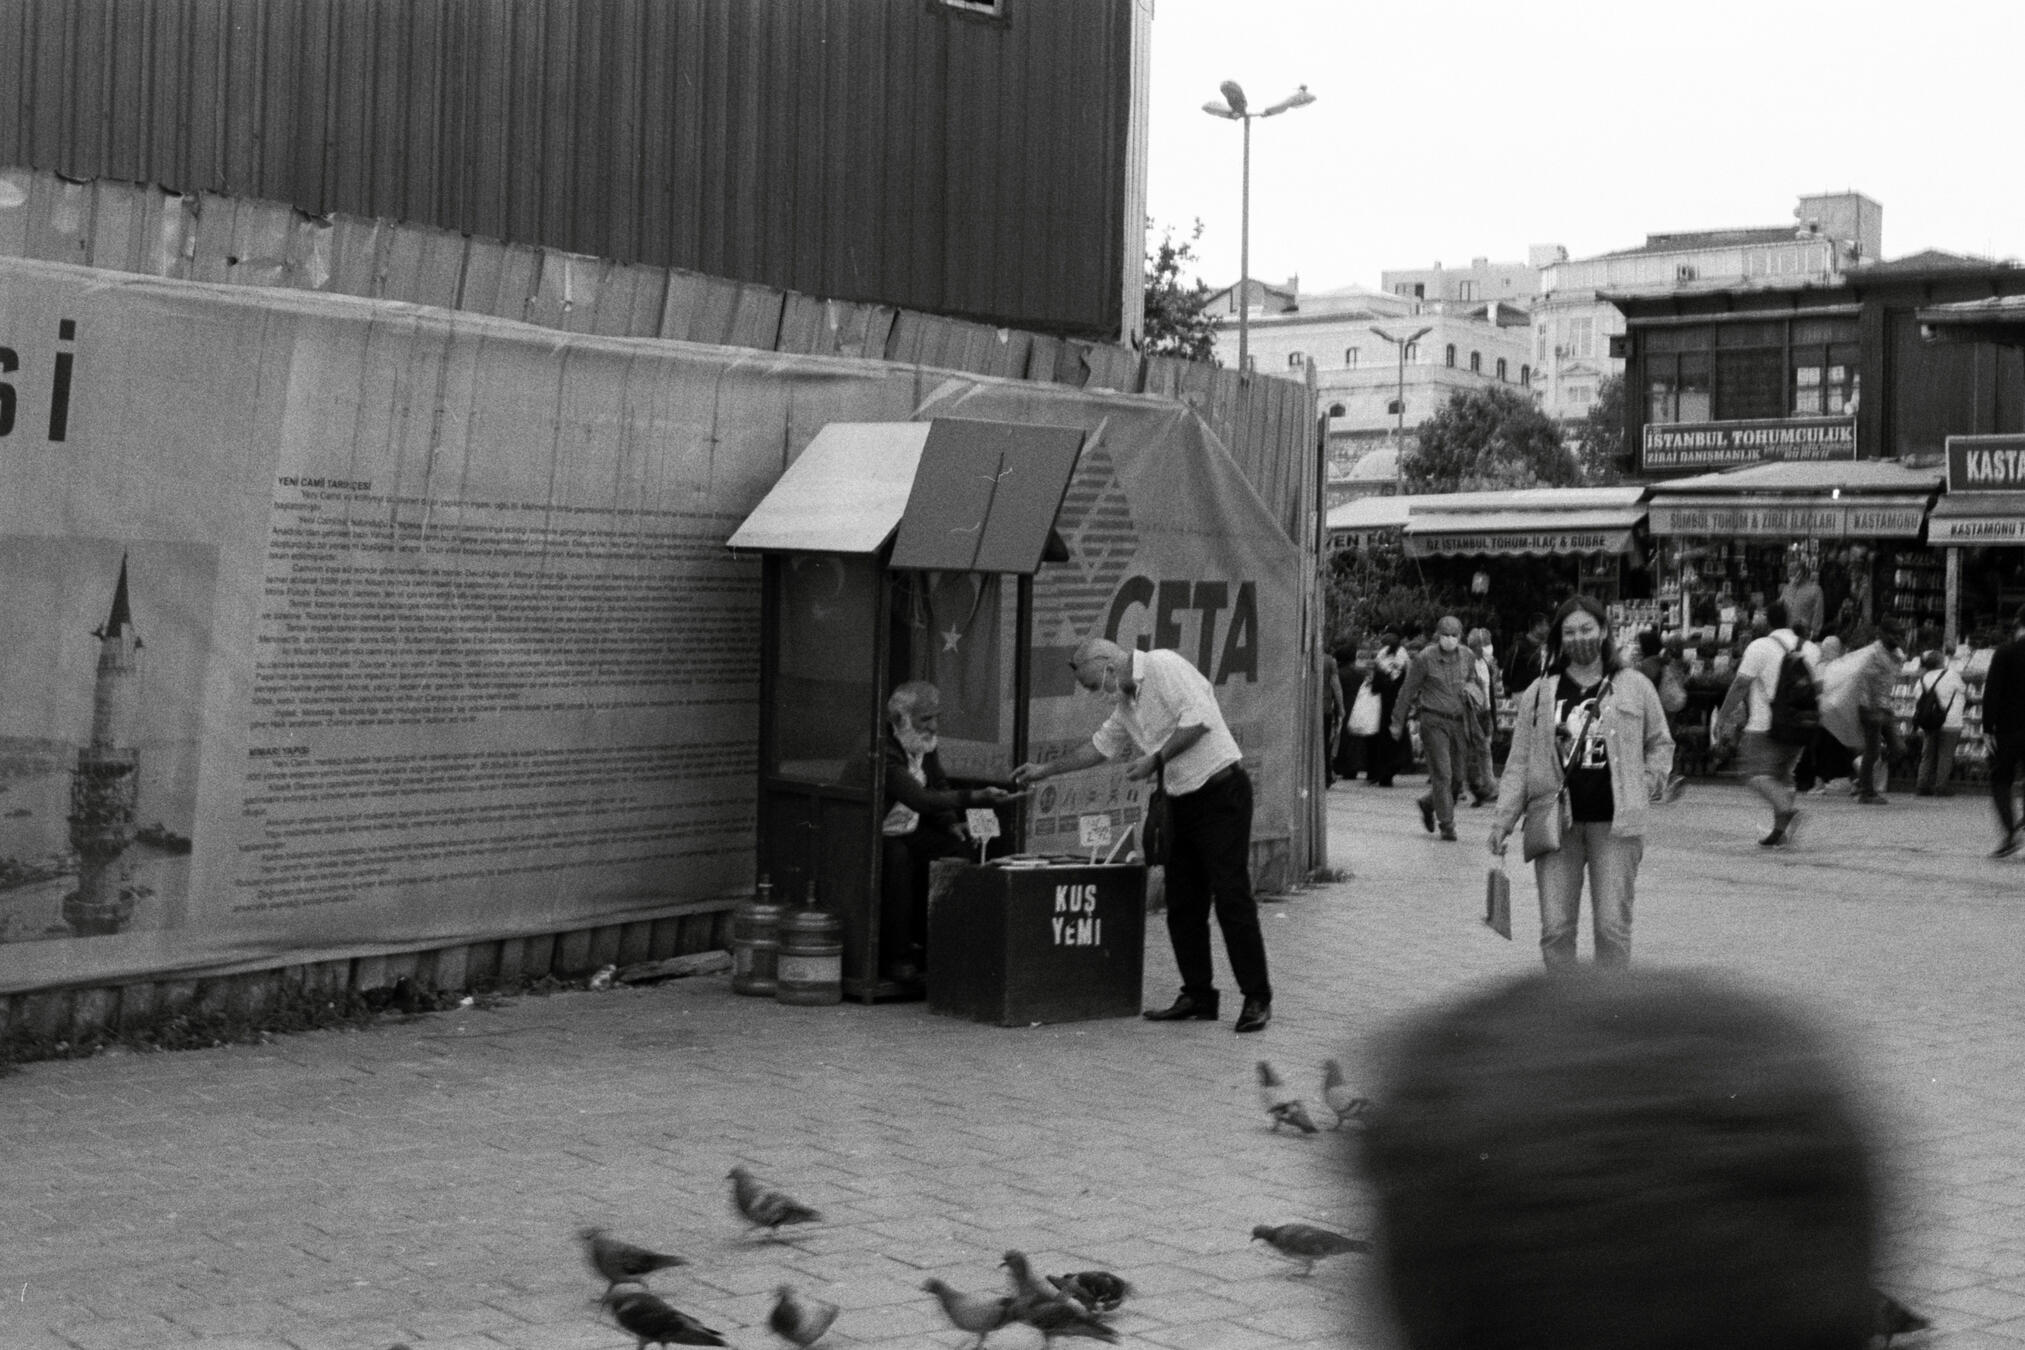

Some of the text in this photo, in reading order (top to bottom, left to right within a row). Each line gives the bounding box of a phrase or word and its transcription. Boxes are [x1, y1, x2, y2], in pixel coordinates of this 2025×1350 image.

[1647, 427, 1853, 448] İSTANBUL TOHUMCULUK
[1055, 884, 1097, 915] KUŞ
